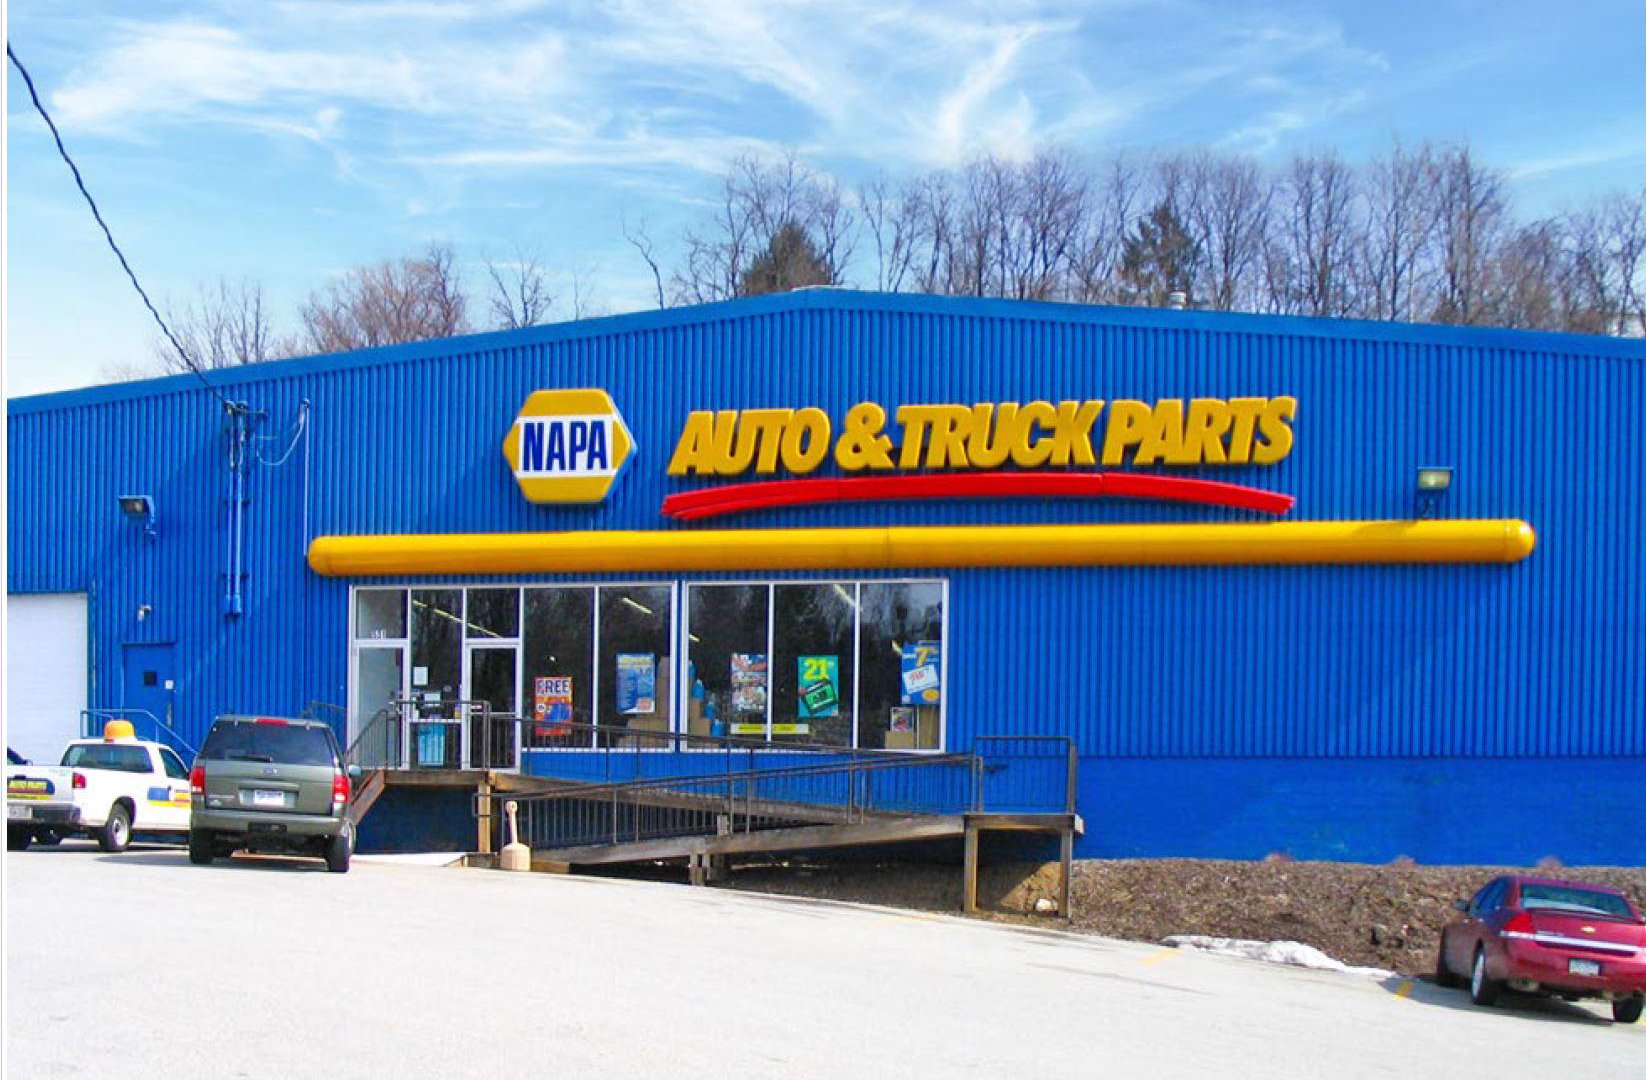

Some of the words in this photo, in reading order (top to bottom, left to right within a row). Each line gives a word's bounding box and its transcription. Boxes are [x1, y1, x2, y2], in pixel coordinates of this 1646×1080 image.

[523, 421, 607, 471] NAPA
[667, 407, 830, 475] AUTO
[835, 402, 893, 470] &
[897, 399, 1104, 468] TRUCK
[1101, 396, 1297, 465] PARTS
[536, 680, 570, 694] FREE
